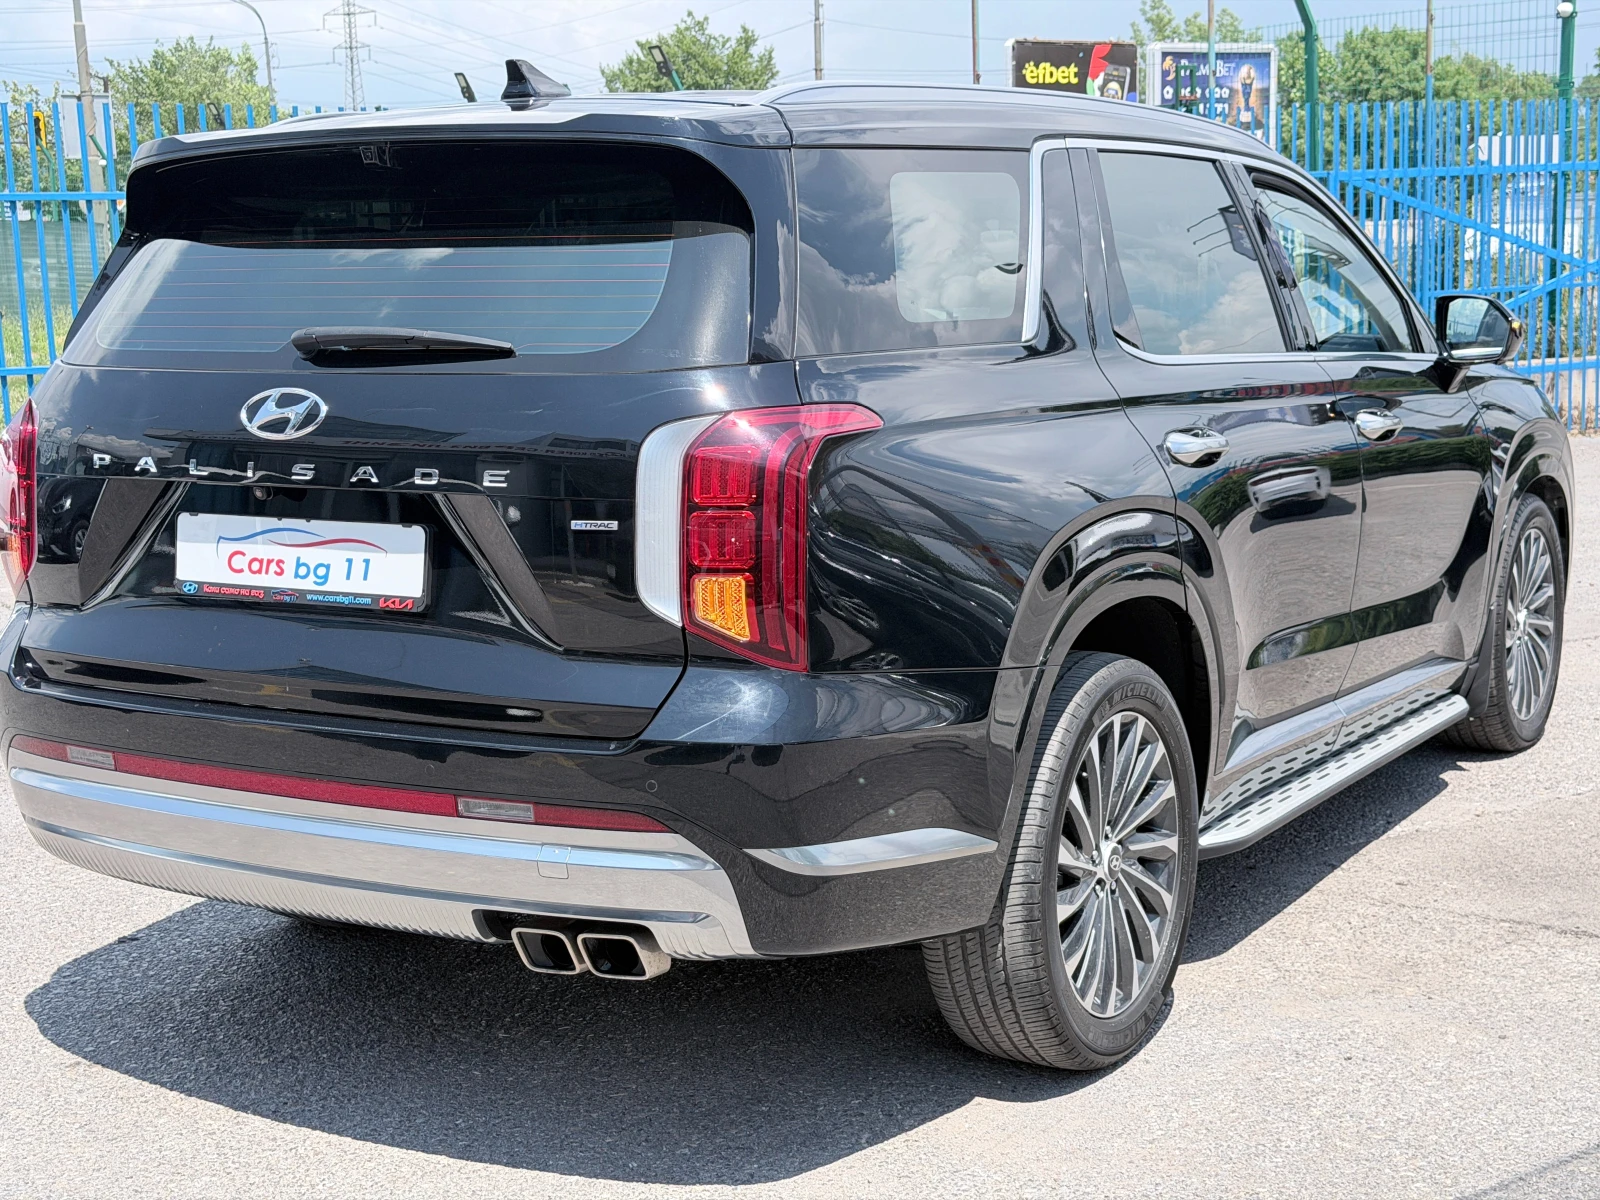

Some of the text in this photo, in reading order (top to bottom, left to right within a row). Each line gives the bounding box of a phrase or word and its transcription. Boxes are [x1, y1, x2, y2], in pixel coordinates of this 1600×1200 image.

[1022, 61, 1079, 84] efbet
[1180, 59, 1210, 77] PM
[92, 453, 510, 488] PALISADE
[573, 521, 616, 530] HTRAC
[227, 550, 371, 587] Cars bg 11
[306, 593, 372, 605] www.carsbg11.com
[379, 597, 414, 610] KIA
[1112, 683, 1166, 711] MICHELIN
